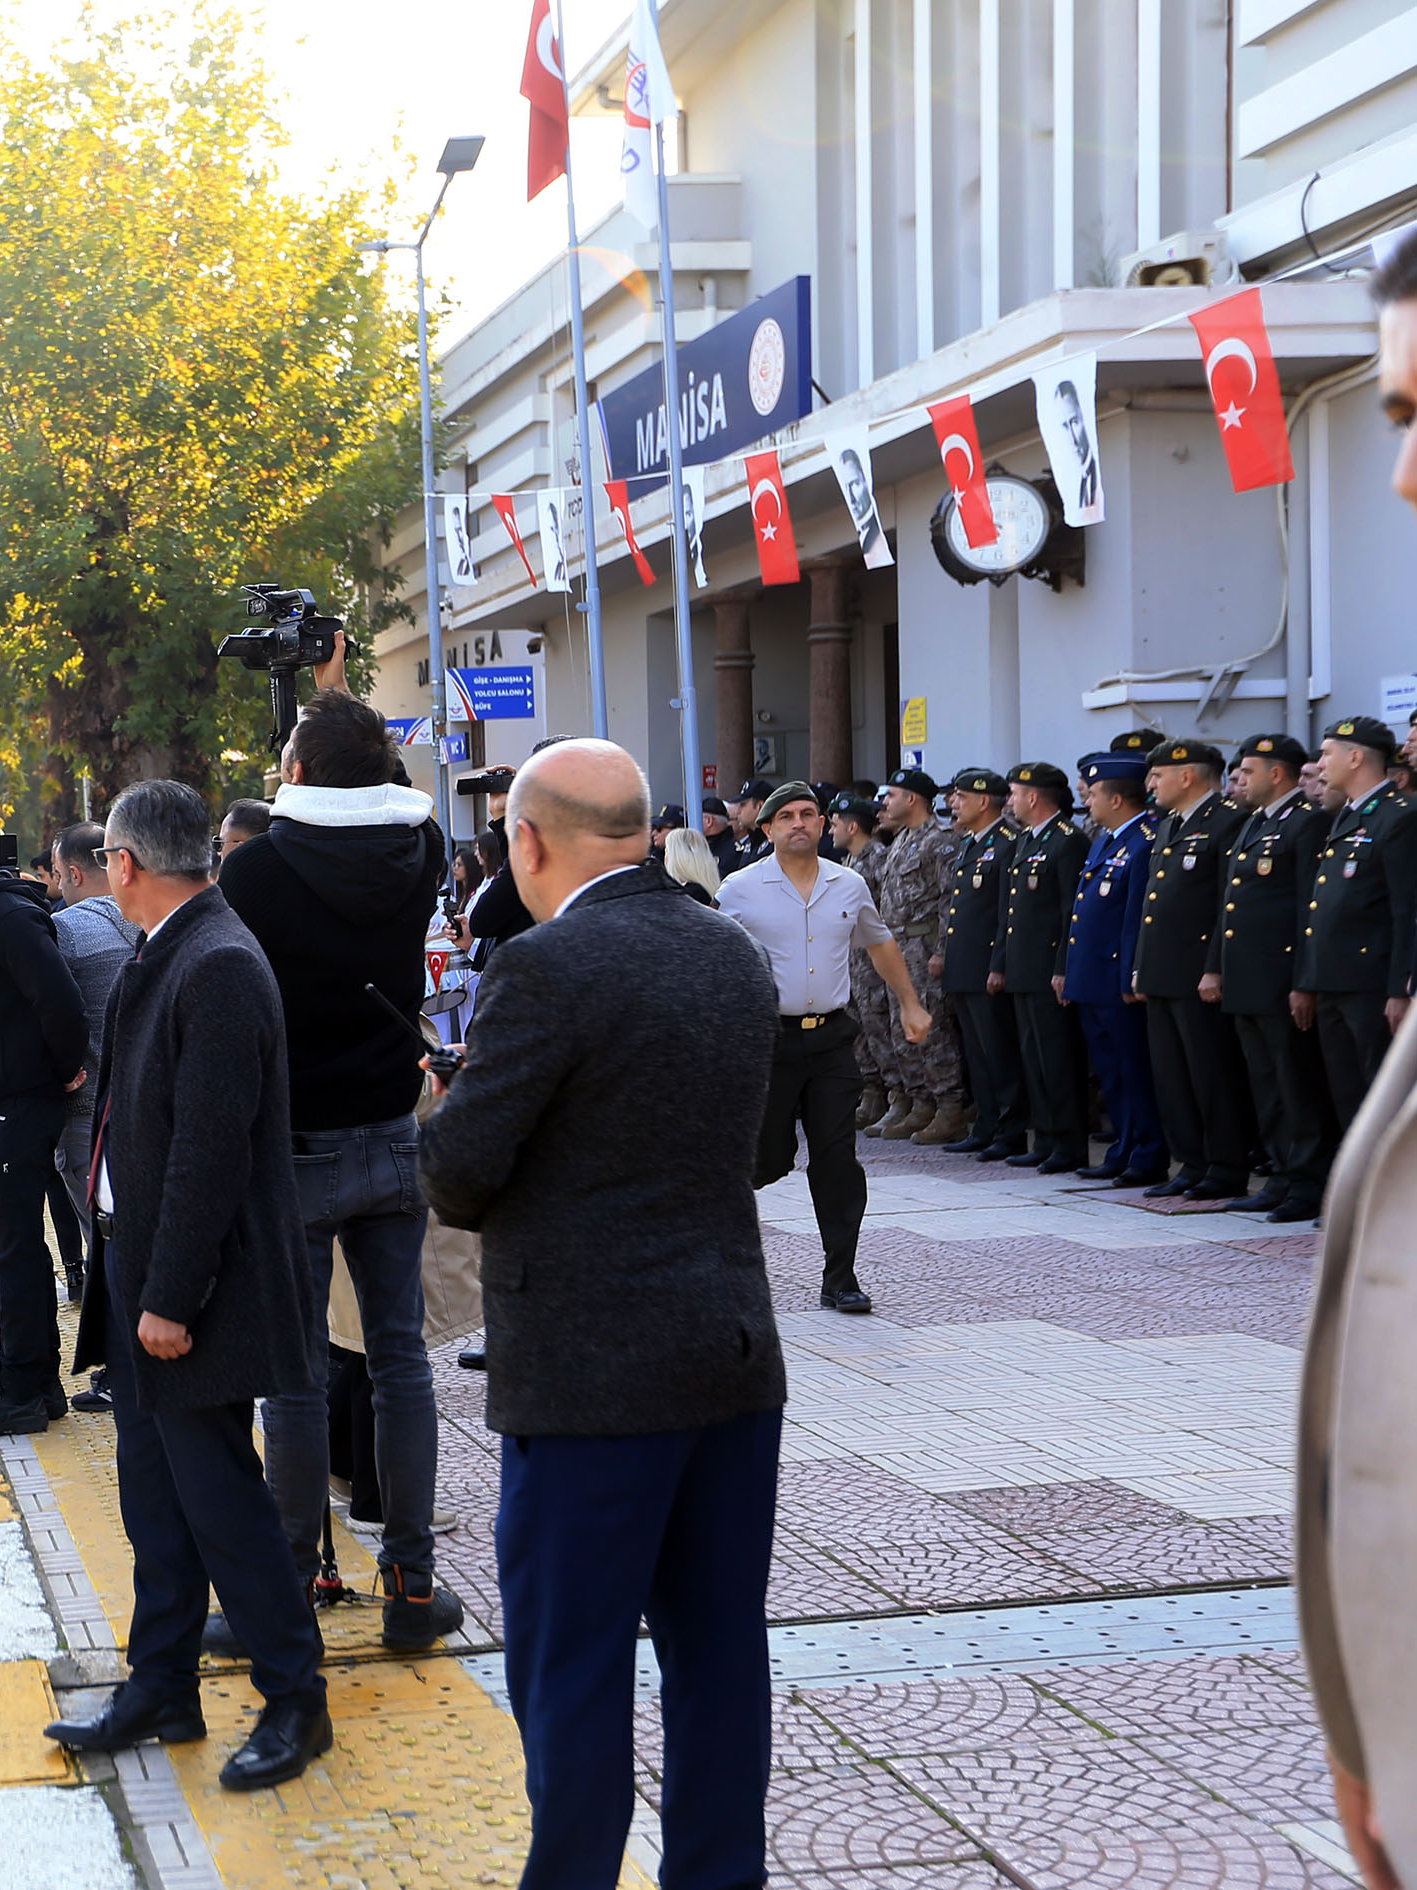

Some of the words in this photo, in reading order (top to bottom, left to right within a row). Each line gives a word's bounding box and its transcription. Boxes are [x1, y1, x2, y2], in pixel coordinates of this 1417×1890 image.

[635, 370, 728, 473] MANİSA
[418, 630, 503, 688] MNISA
[493, 675, 524, 684] DANIŞMA
[474, 689, 497, 698] YOLCU
[498, 688, 524, 697] SALONU
[474, 701, 492, 710] BÜFE
